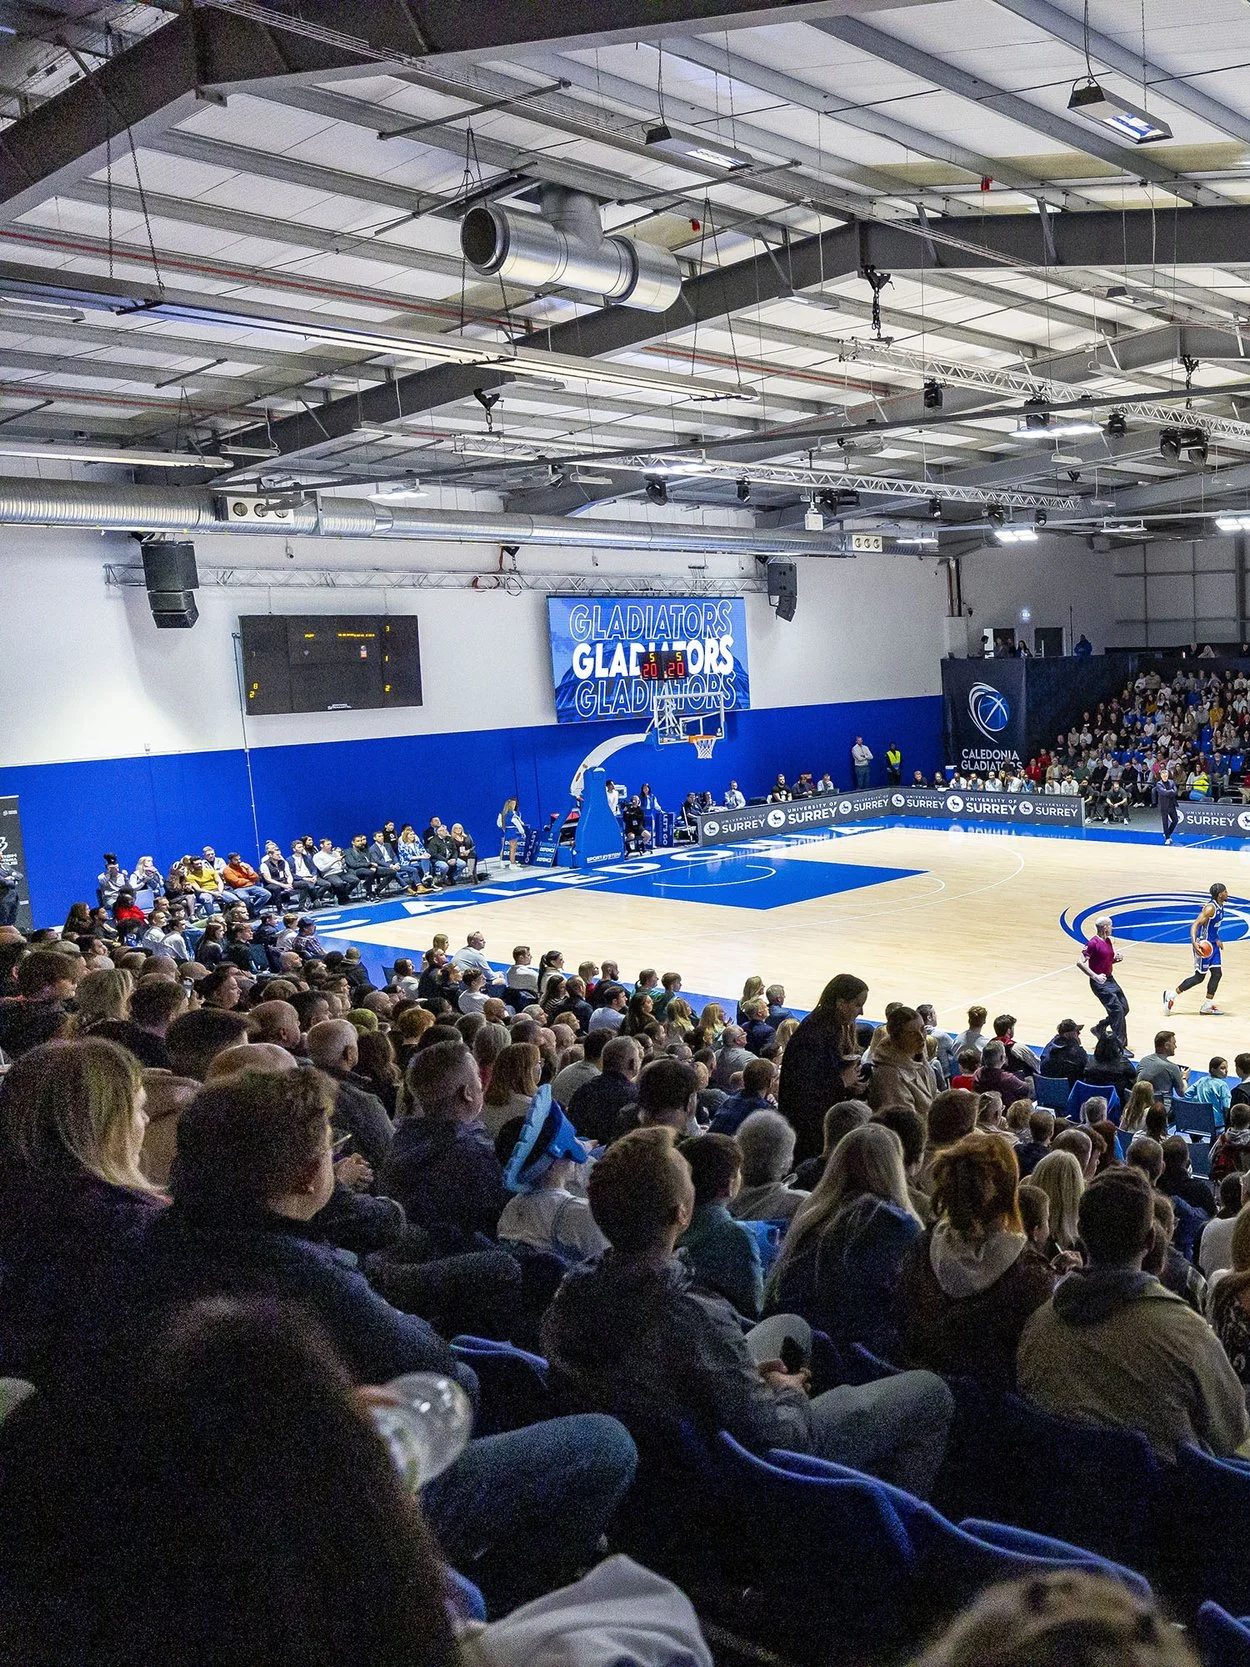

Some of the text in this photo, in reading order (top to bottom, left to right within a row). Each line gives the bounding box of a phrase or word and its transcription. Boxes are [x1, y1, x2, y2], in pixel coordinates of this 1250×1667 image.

[570, 600, 732, 642] GLADIATORS
[643, 662, 684, 676] 20 20
[962, 749, 1020, 760] CALEDONIA
[787, 804, 826, 813] UNIVERSITY
[854, 799, 888, 811] SURREY
[907, 800, 944, 808] SURREY
[966, 803, 1017, 815] SURREY
[788, 807, 837, 824] SURREY
[1036, 807, 1078, 817] SURREY
[722, 819, 765, 834] SURREY
[1187, 816, 1235, 826] SURREY
[663, 834, 668, 845] GO
